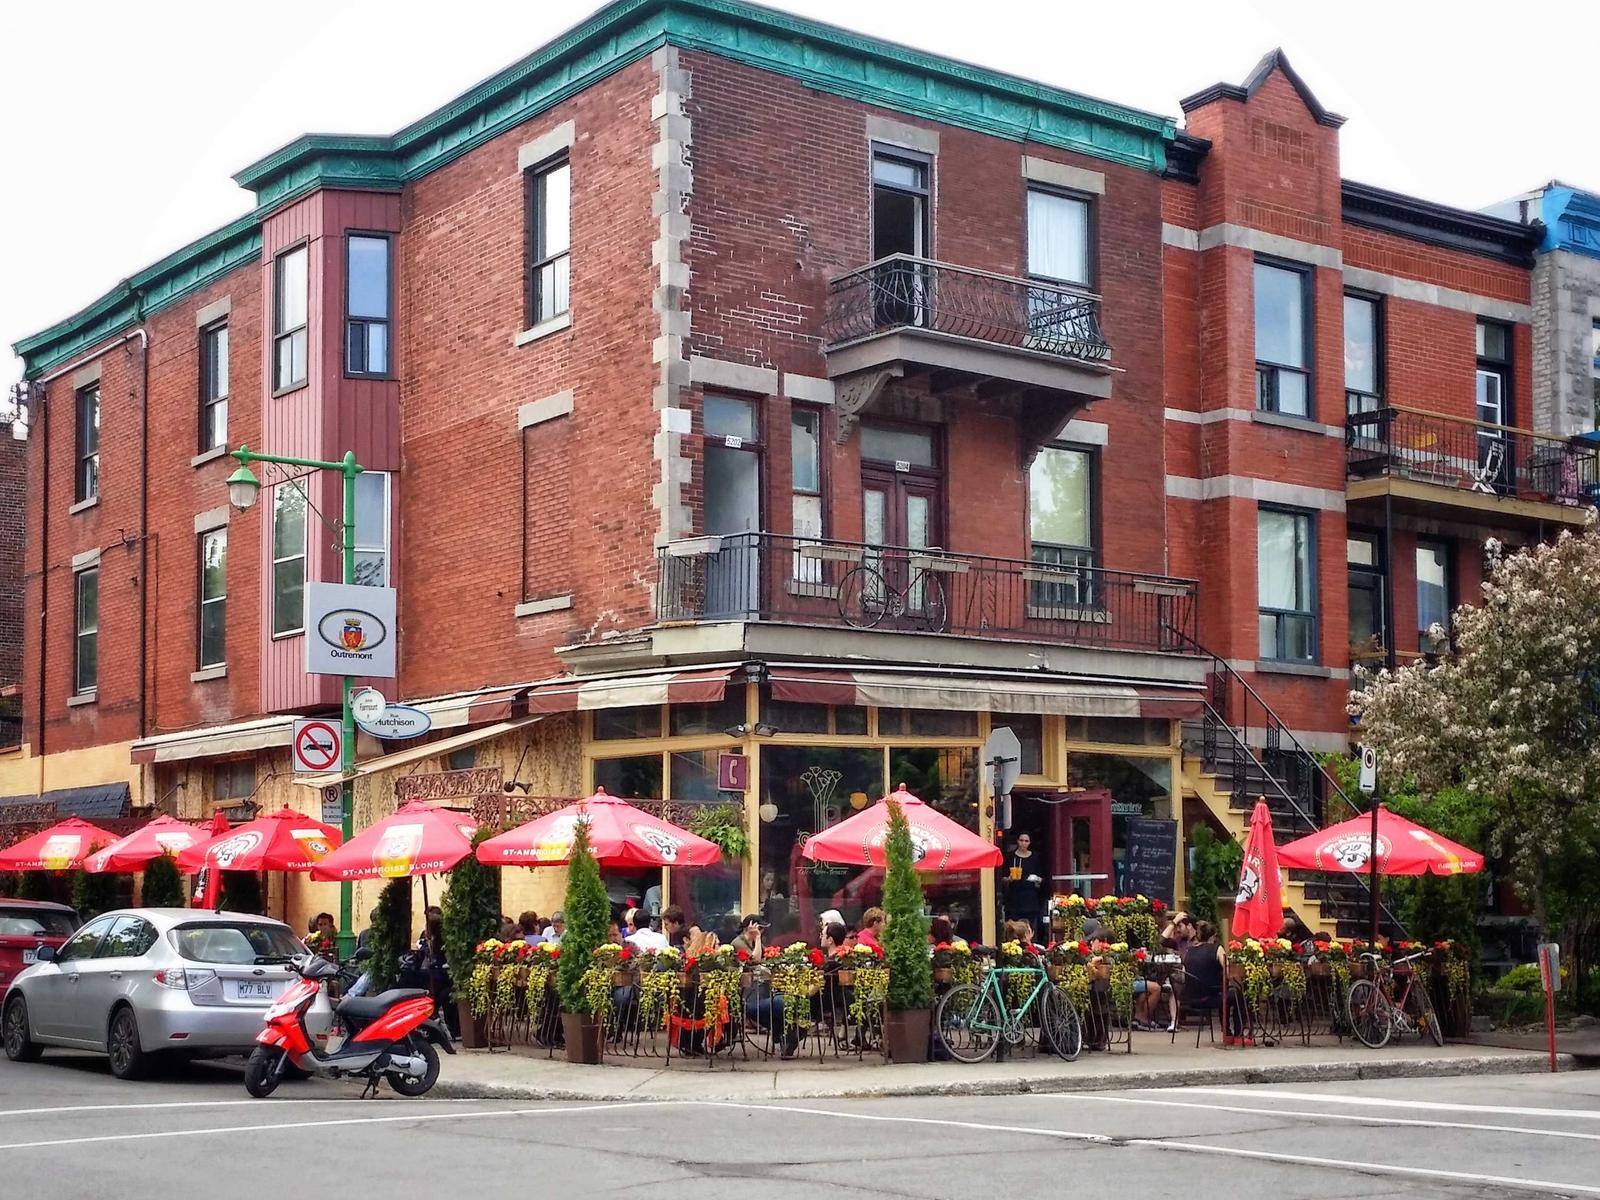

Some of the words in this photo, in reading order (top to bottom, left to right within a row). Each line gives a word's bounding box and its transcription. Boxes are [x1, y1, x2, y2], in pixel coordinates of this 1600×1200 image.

[330, 649, 373, 660] Outremont
[342, 864, 406, 877] ST-AMBROISE
[409, 860, 445, 871] BLONDE
[240, 984, 254, 994] M77
[257, 985, 271, 995] BLV
